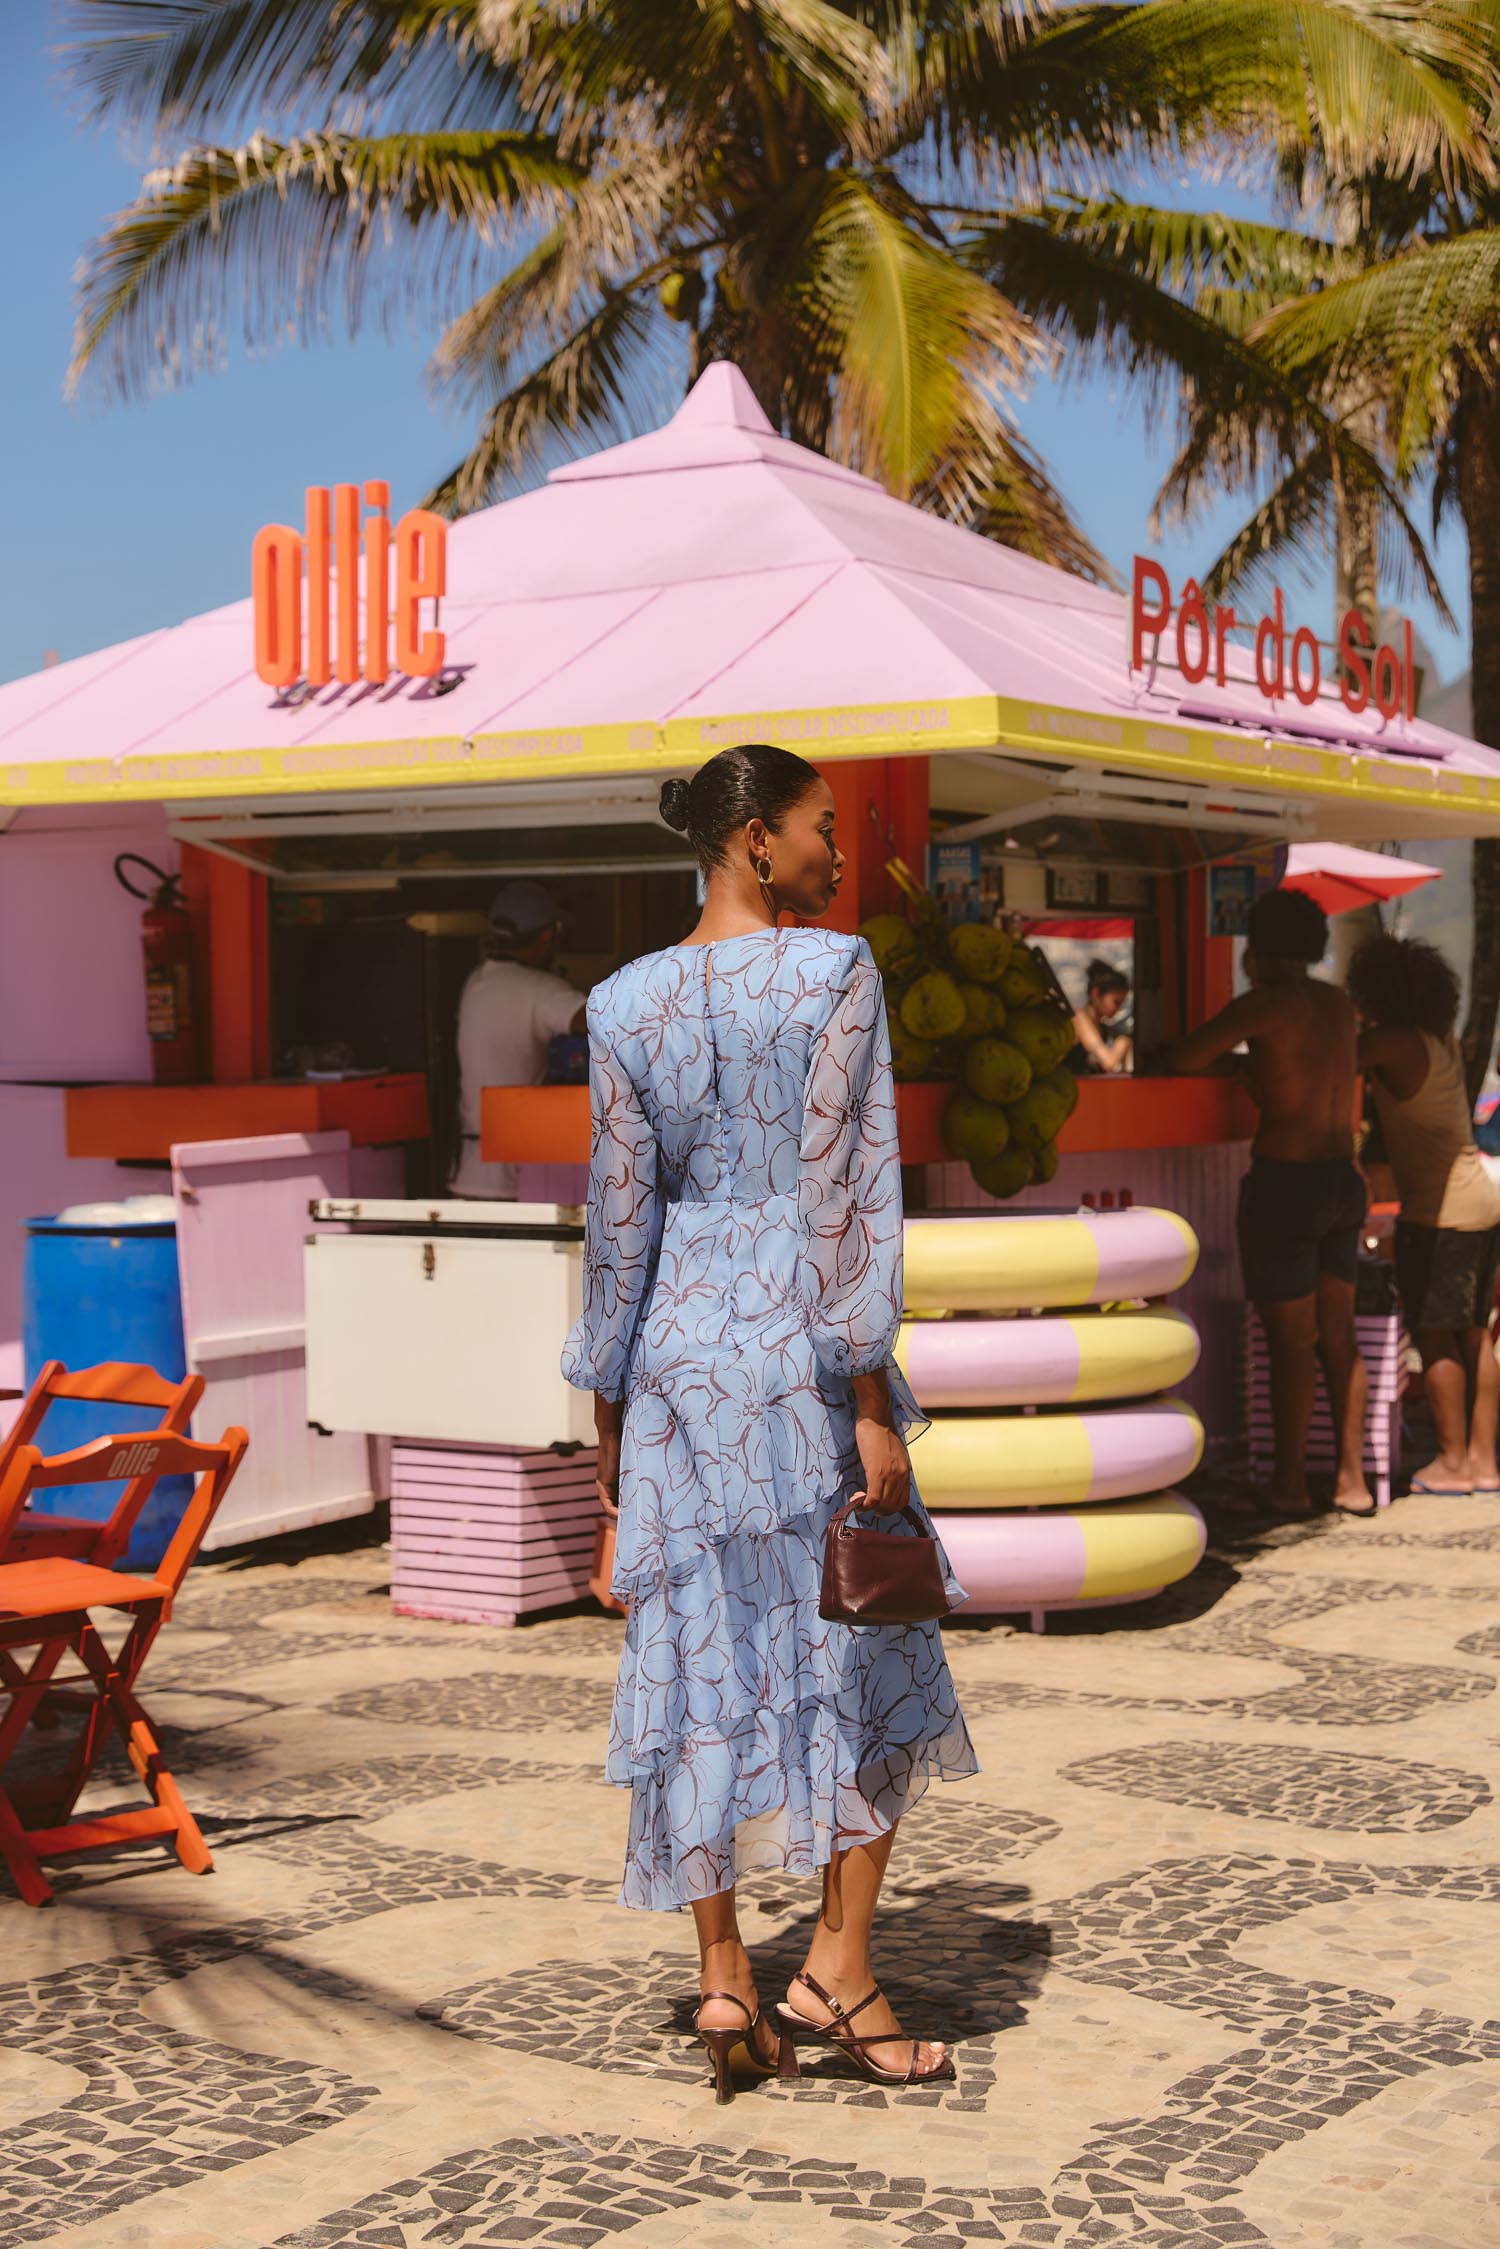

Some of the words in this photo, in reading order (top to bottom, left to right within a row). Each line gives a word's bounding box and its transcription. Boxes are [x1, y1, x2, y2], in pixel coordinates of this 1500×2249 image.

[253, 480, 448, 687] ollie
[1132, 555, 1236, 688] Pôr
[1256, 586, 1320, 706] do
[1340, 608, 1415, 722] Sol
[699, 715, 774, 746] PROTEÇÃO
[776, 714, 823, 741] SOLAR
[827, 706, 951, 737] DESCOMPLICADA
[107, 1442, 160, 1478] ollie
